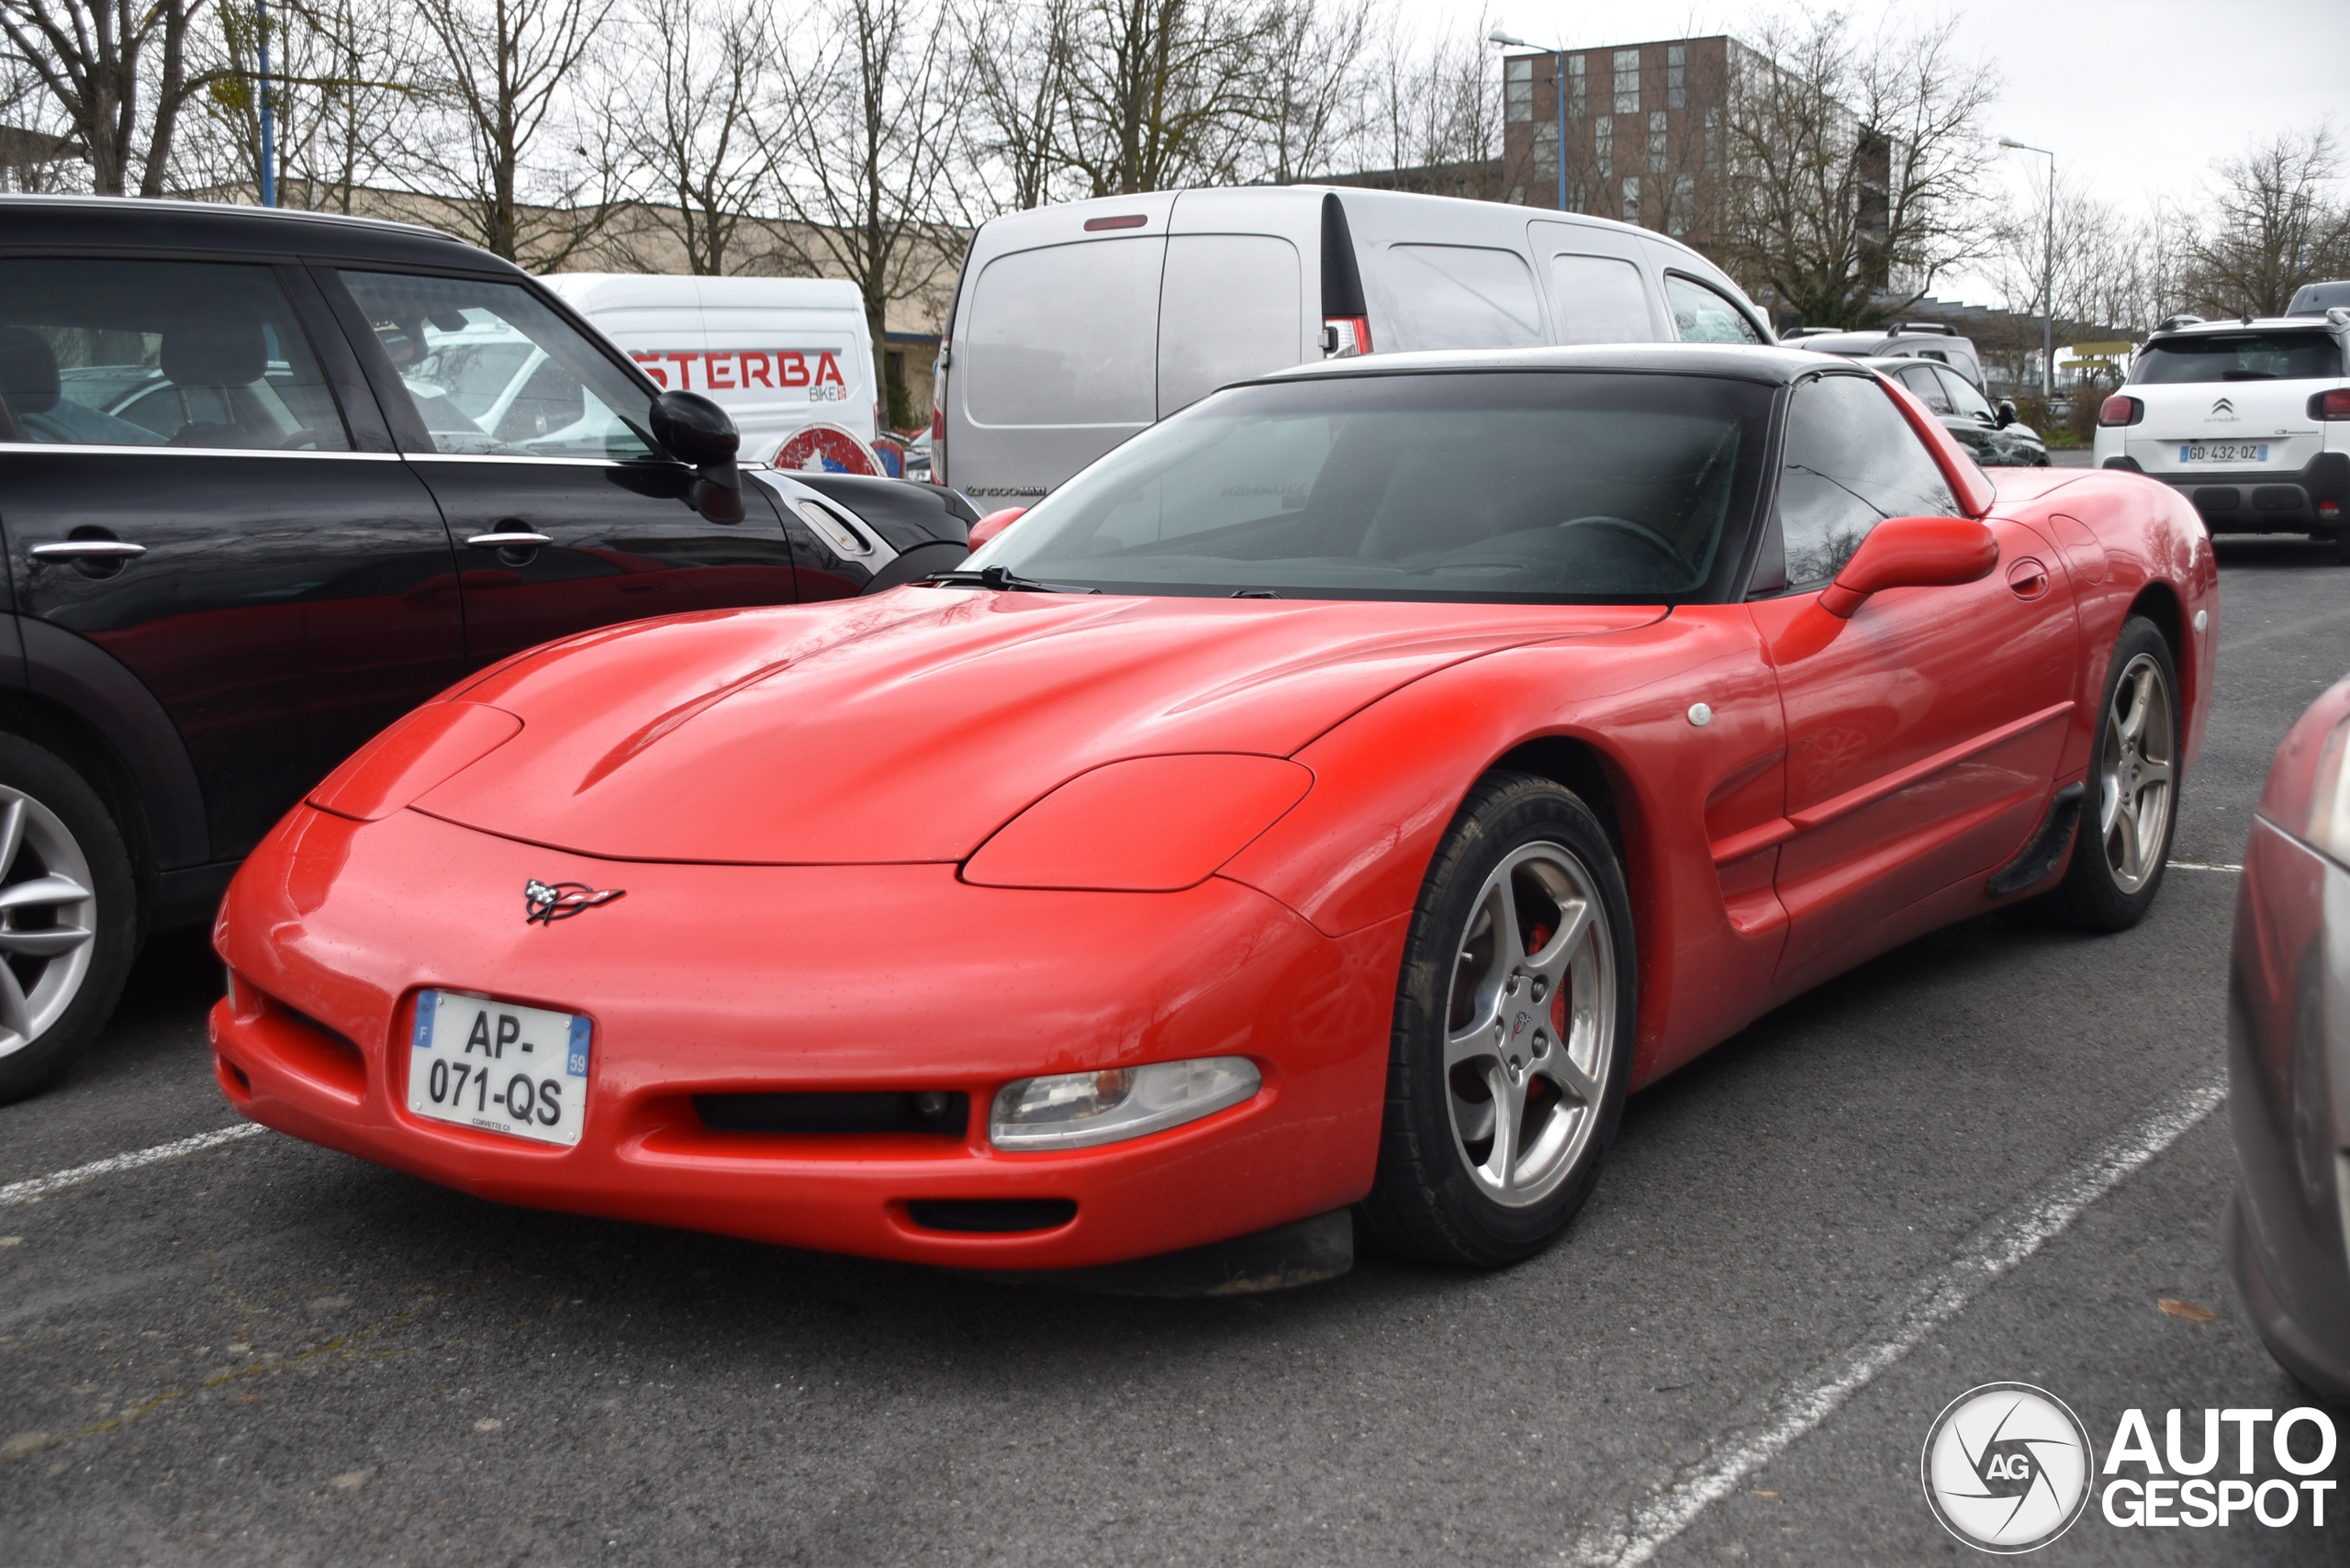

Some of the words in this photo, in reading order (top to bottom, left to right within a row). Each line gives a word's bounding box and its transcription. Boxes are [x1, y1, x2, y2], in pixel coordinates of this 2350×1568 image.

[809, 386, 836, 402] BIKE
[1019, 487, 1046, 497] MAXI
[419, 1026, 428, 1041] F
[569, 1054, 586, 1073] 59
[430, 1058, 563, 1126] 071-QS
[472, 1117, 502, 1130] CORVETTE
[502, 1123, 510, 1132] C5
